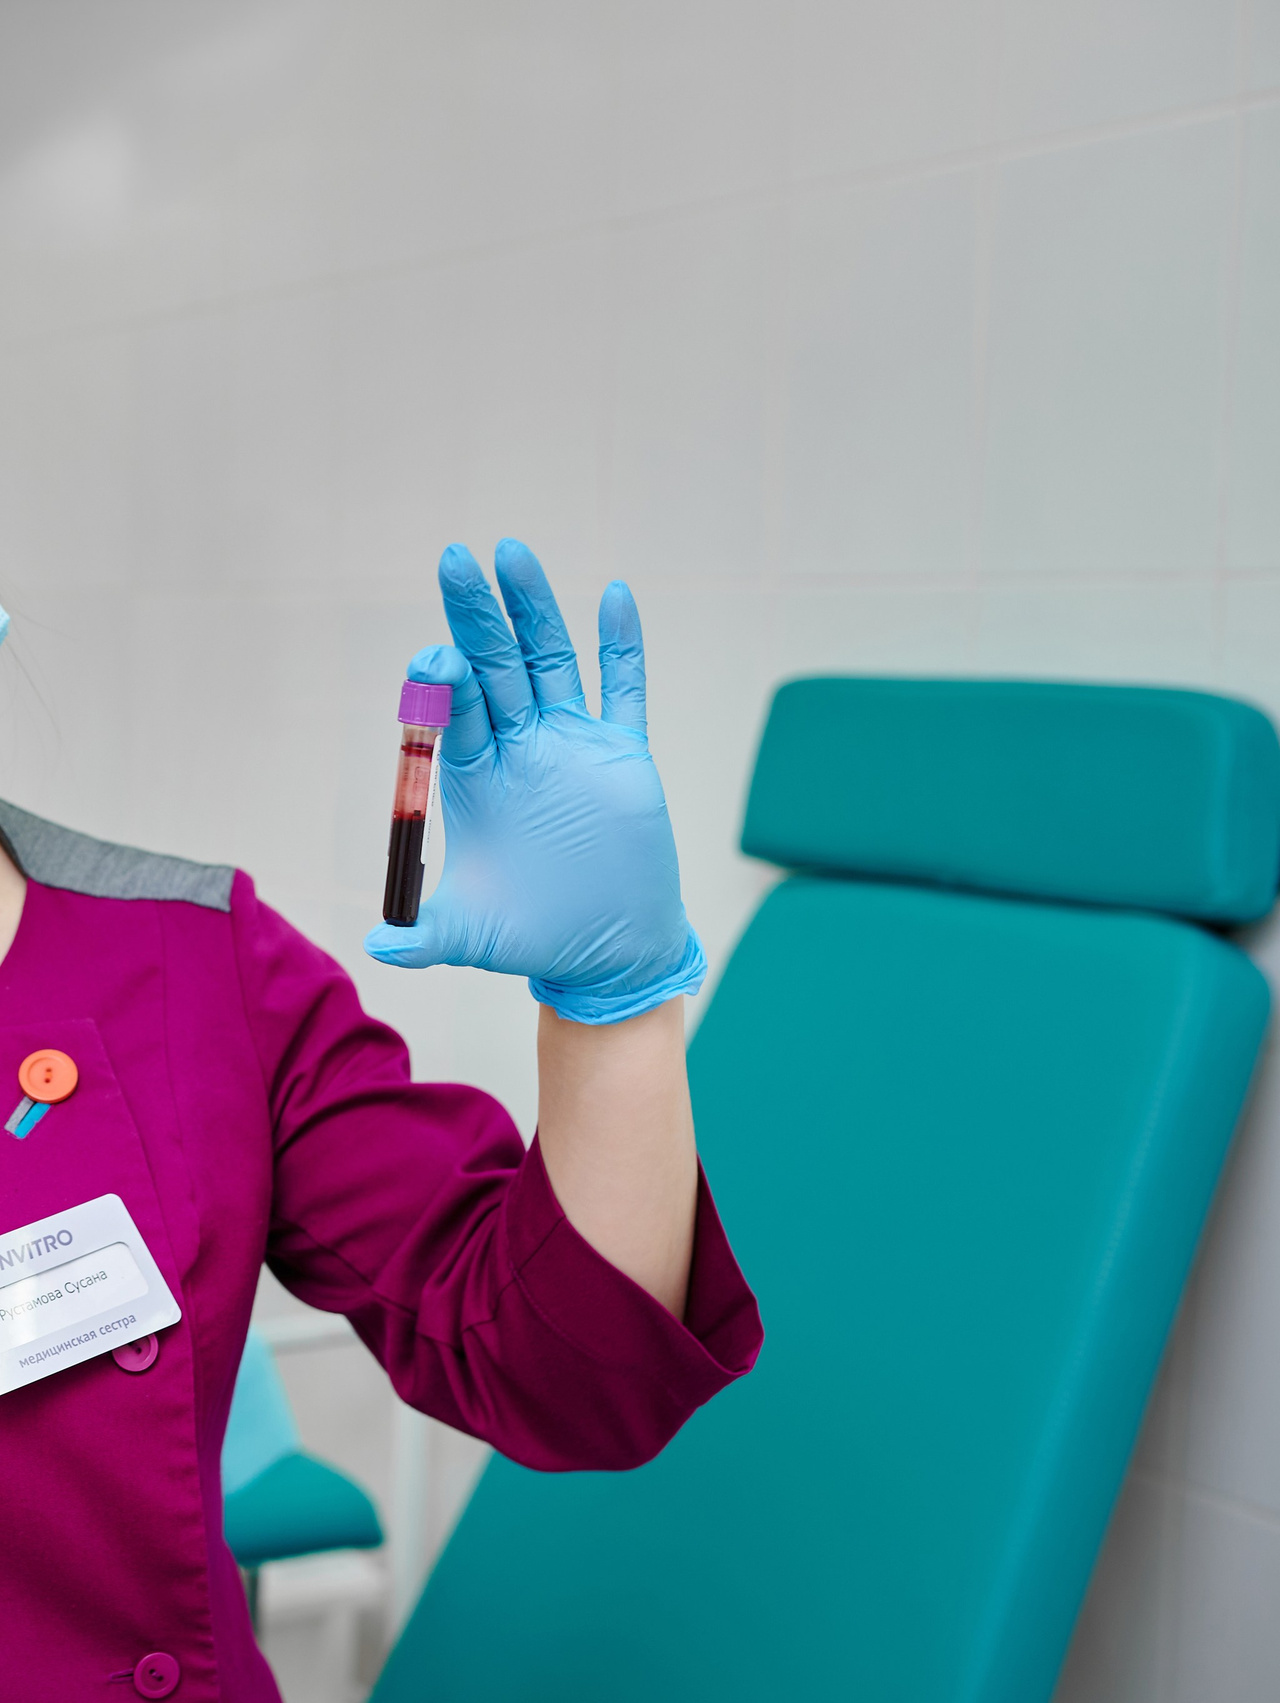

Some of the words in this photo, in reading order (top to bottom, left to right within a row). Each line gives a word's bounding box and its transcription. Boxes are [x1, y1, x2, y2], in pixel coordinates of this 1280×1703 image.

[64, 1269, 108, 1294] Сусана
[19, 1331, 97, 1368] медицинская
[100, 1313, 137, 1336] сестра
